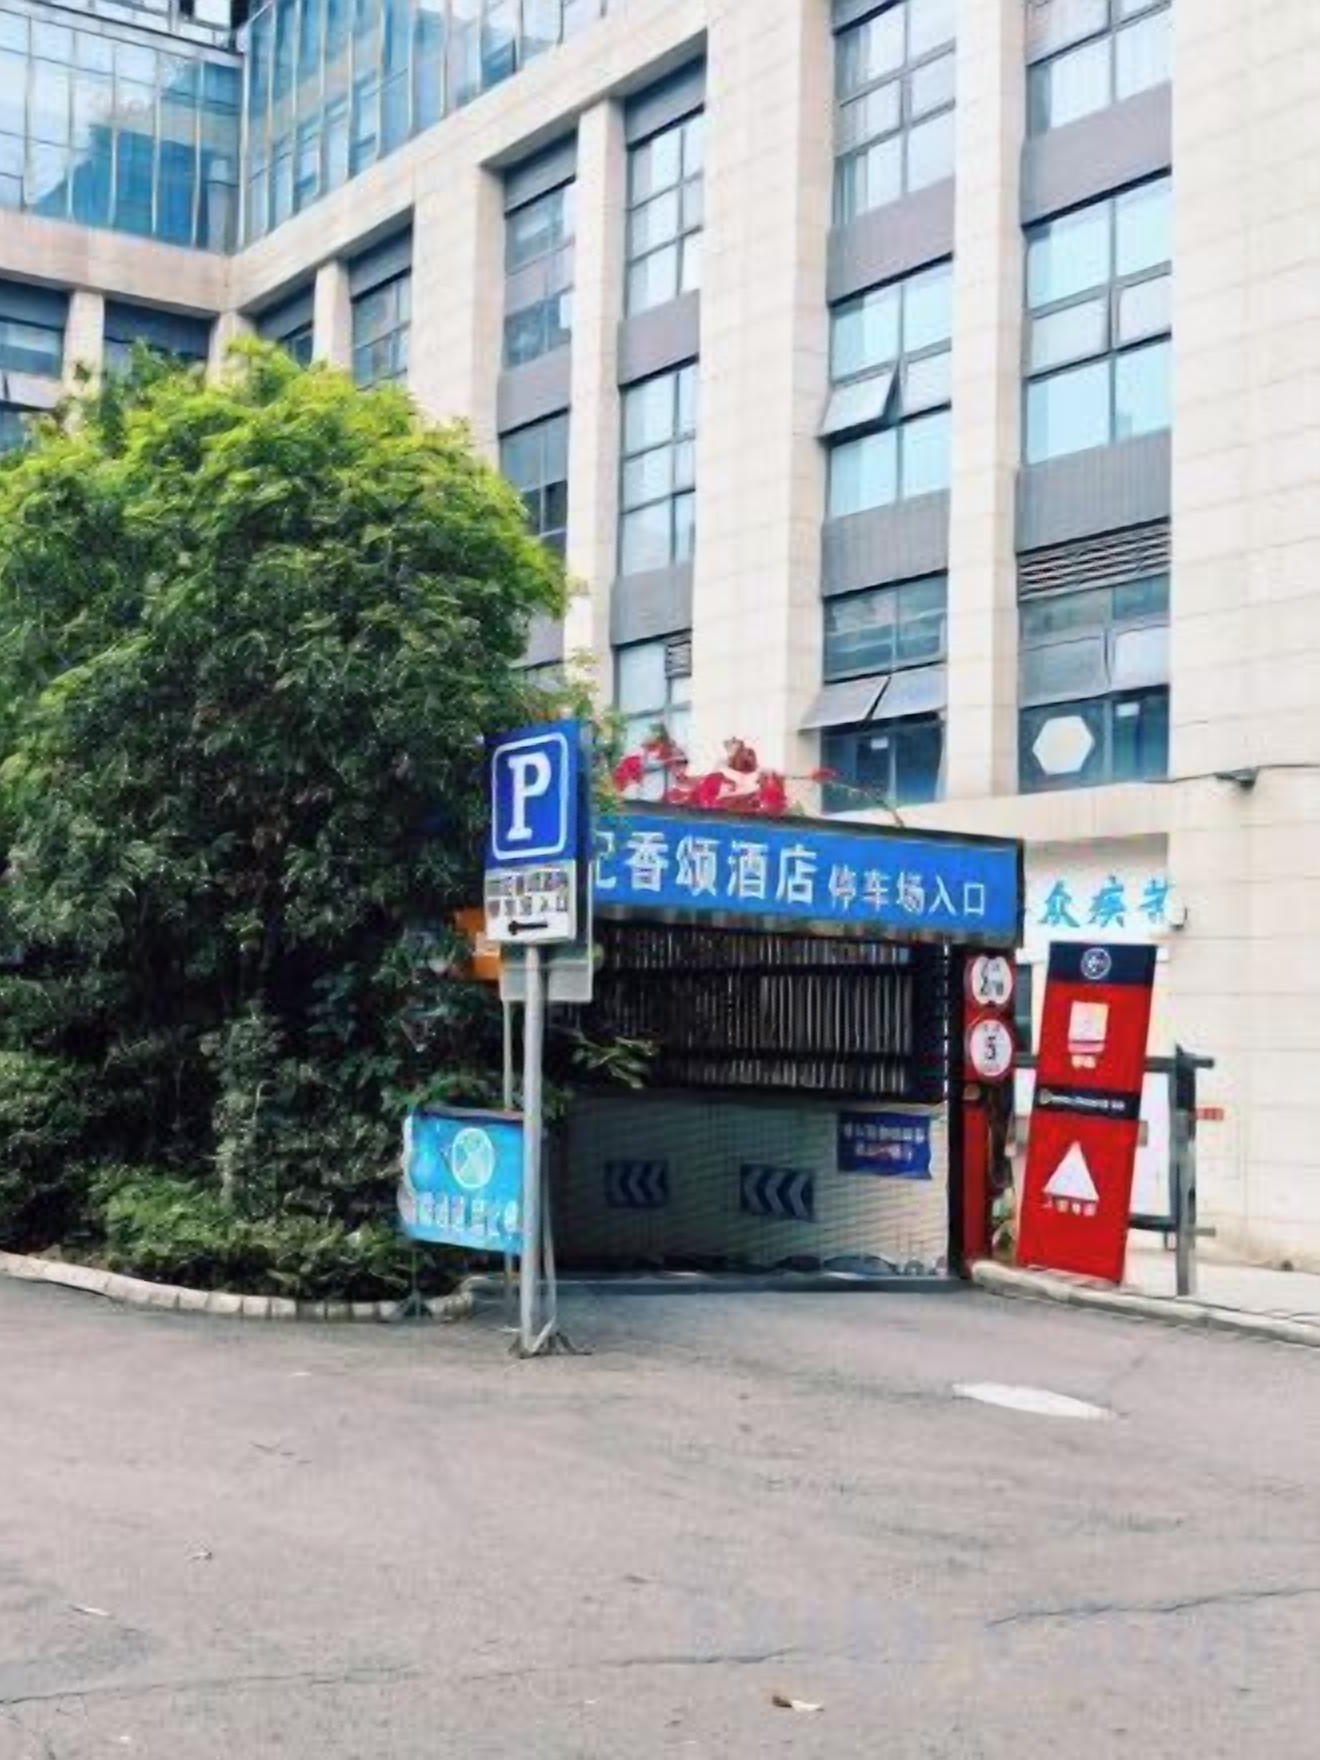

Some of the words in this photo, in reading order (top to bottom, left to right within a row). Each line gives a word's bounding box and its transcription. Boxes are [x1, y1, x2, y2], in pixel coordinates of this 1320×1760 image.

[506, 751, 551, 841] P
[828, 862, 986, 917] 停车场入口
